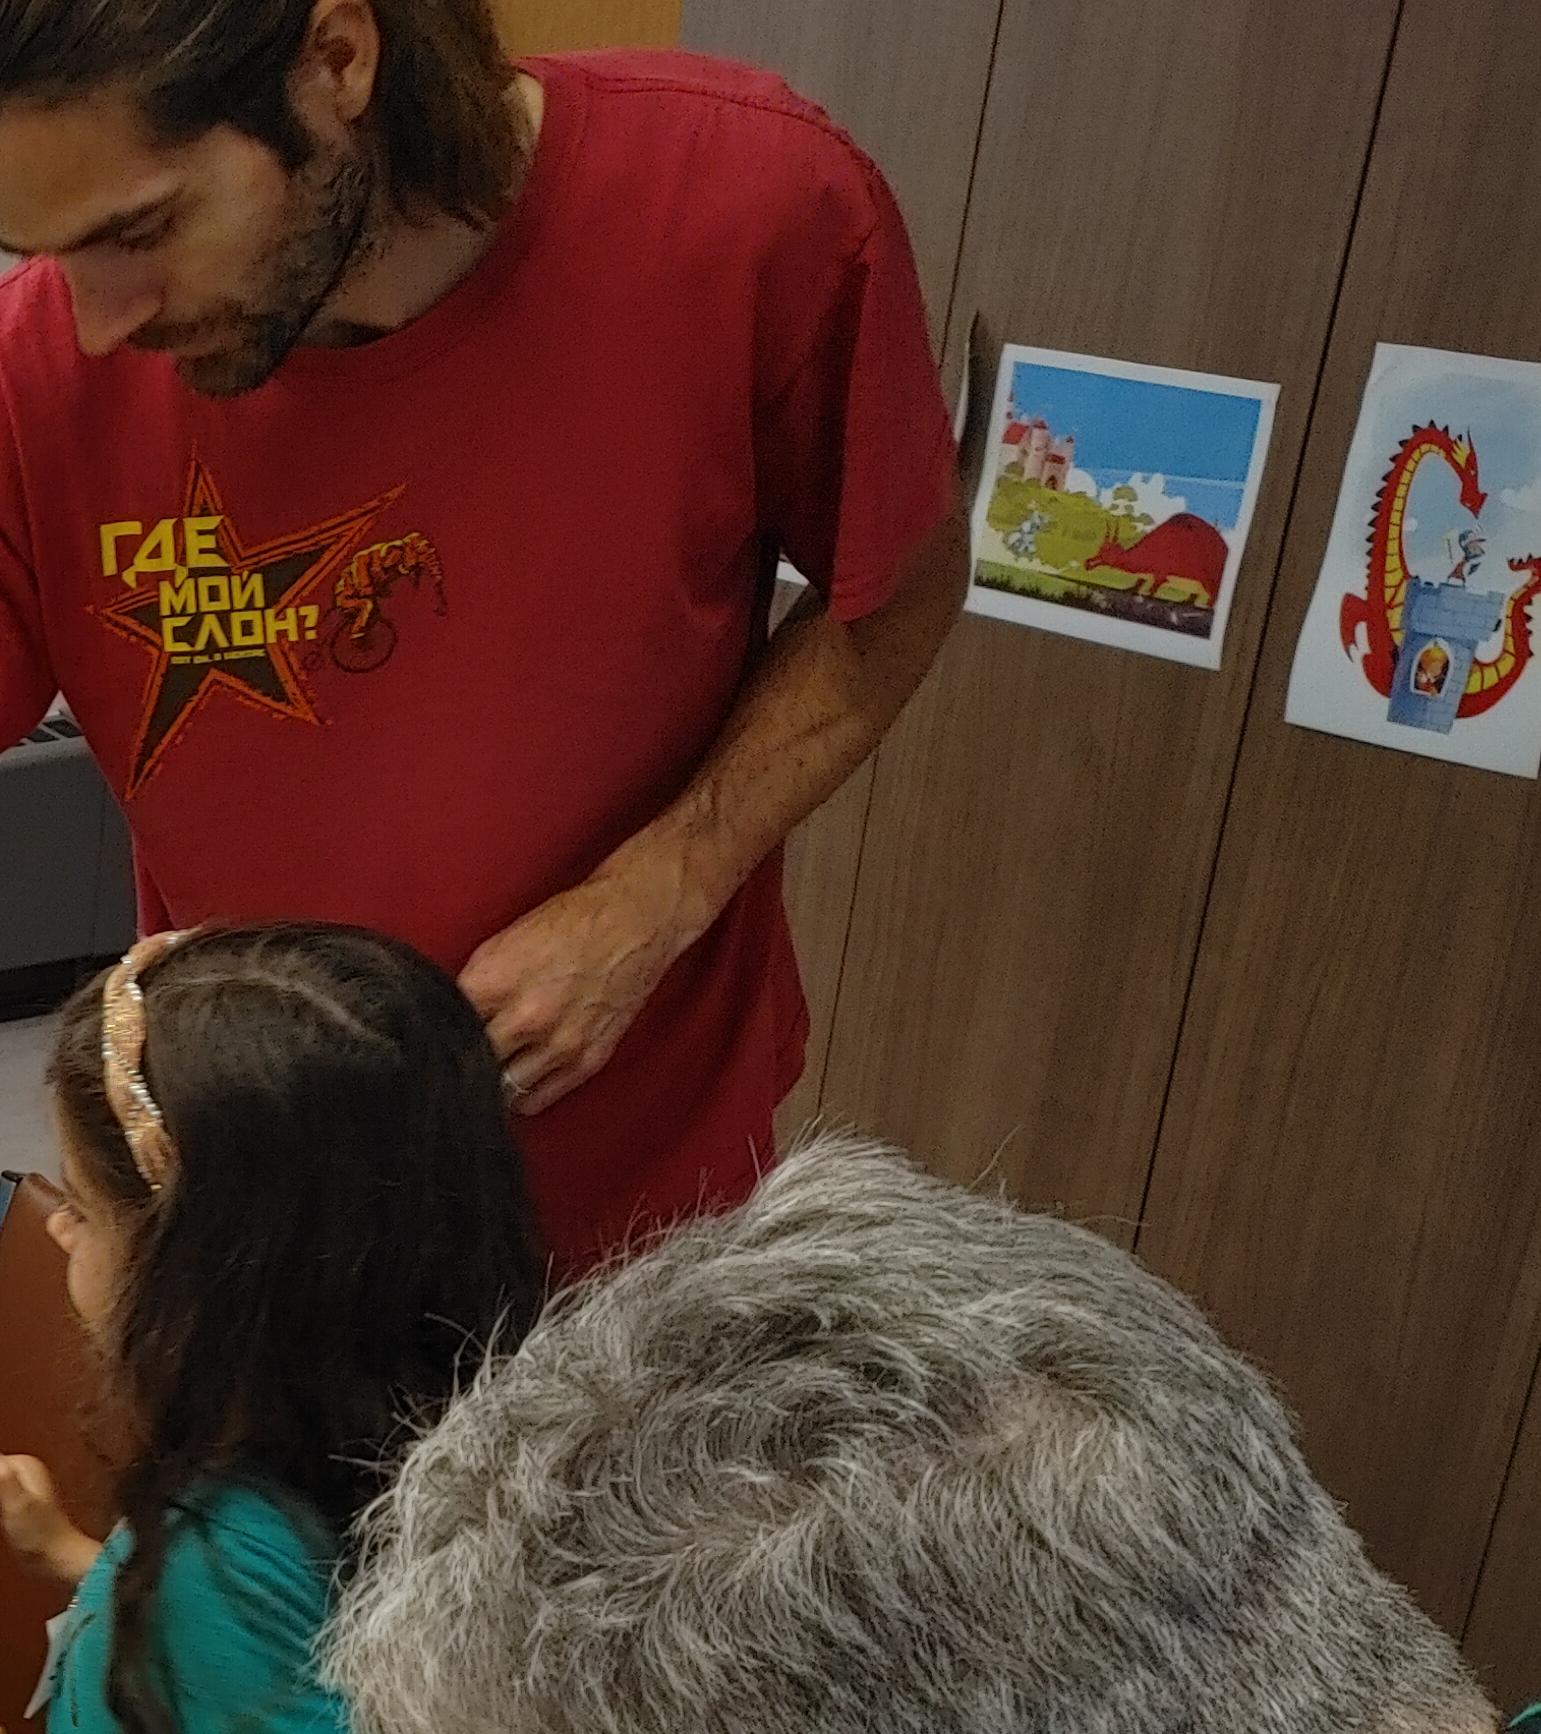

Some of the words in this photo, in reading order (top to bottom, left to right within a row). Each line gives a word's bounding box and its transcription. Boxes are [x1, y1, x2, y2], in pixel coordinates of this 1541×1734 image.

[99, 514, 230, 589] ГДЕ
[158, 568, 265, 616] МОЙ
[161, 604, 320, 653] СЛОН?
